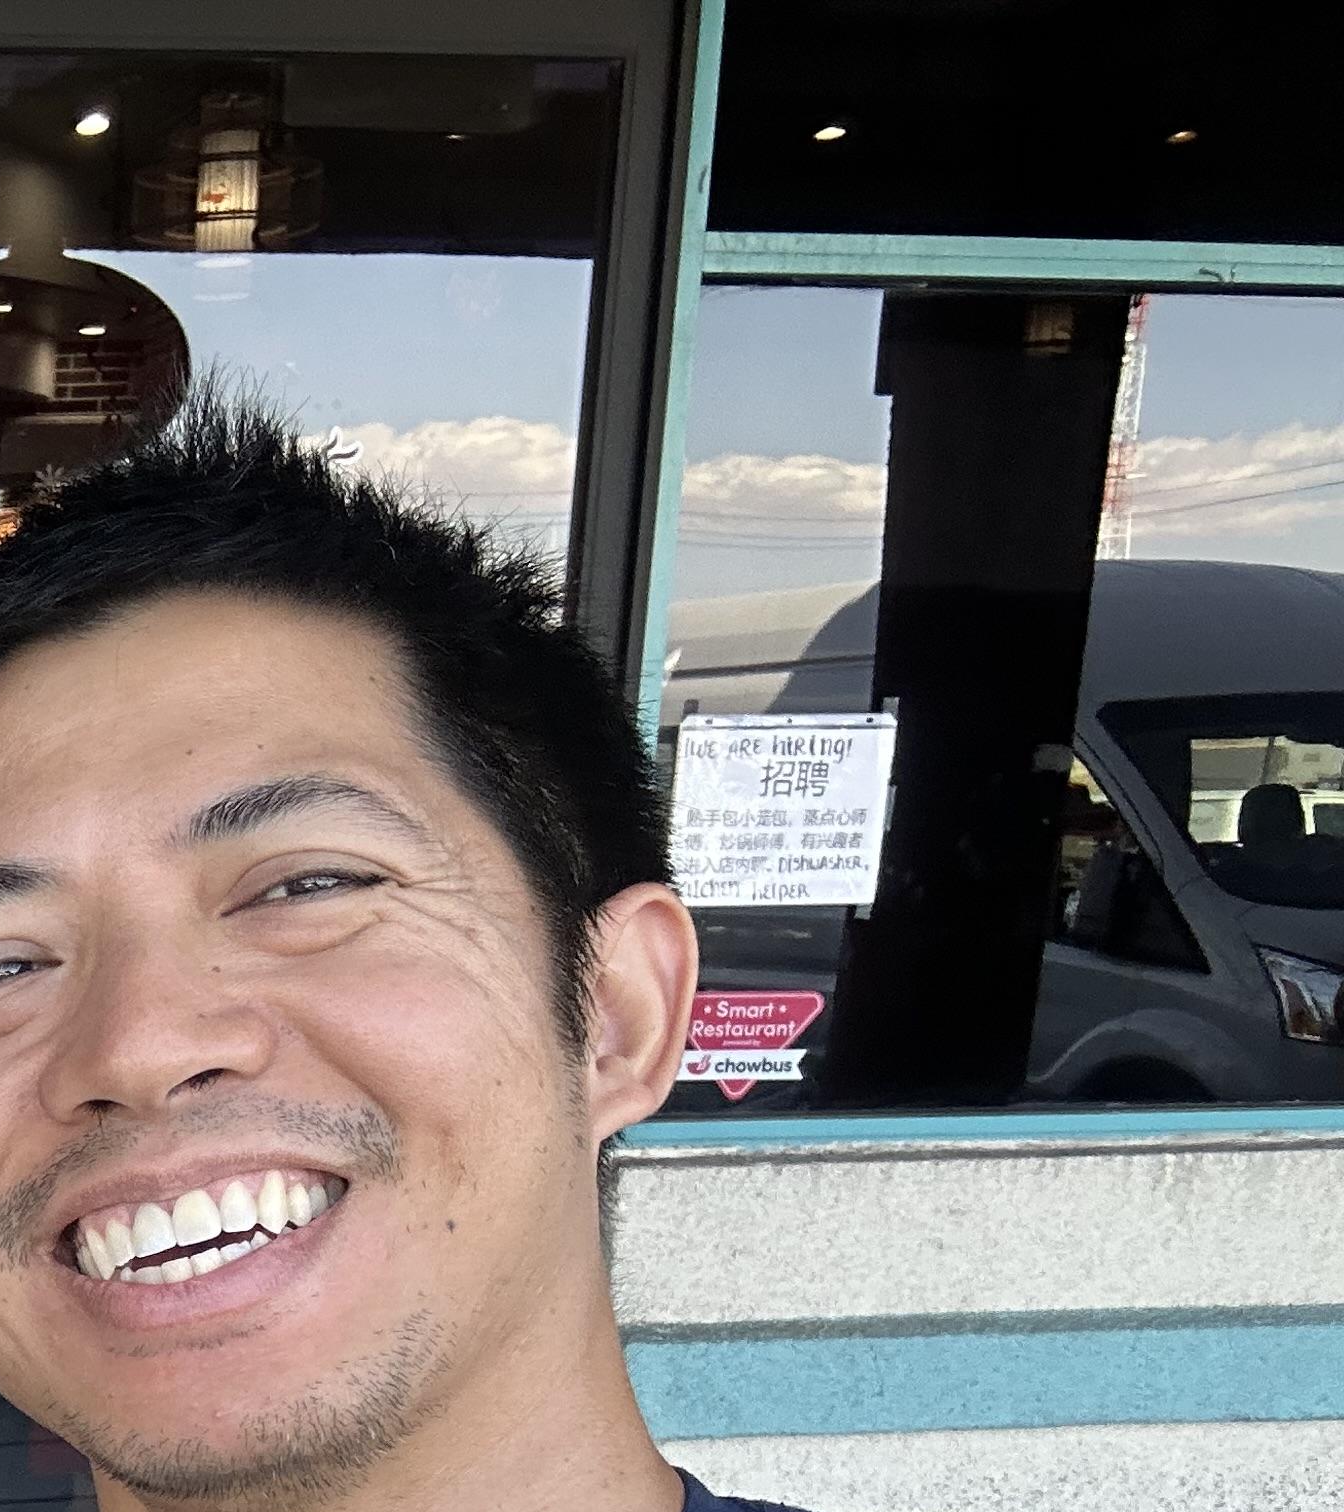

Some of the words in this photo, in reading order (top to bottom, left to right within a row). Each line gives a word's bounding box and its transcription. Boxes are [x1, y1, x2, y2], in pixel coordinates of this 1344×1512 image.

[759, 758, 830, 798] 招聘
[716, 1001, 774, 1019] Smart
[692, 1020, 796, 1038] Restaurant
[715, 1056, 793, 1074] chowbus
